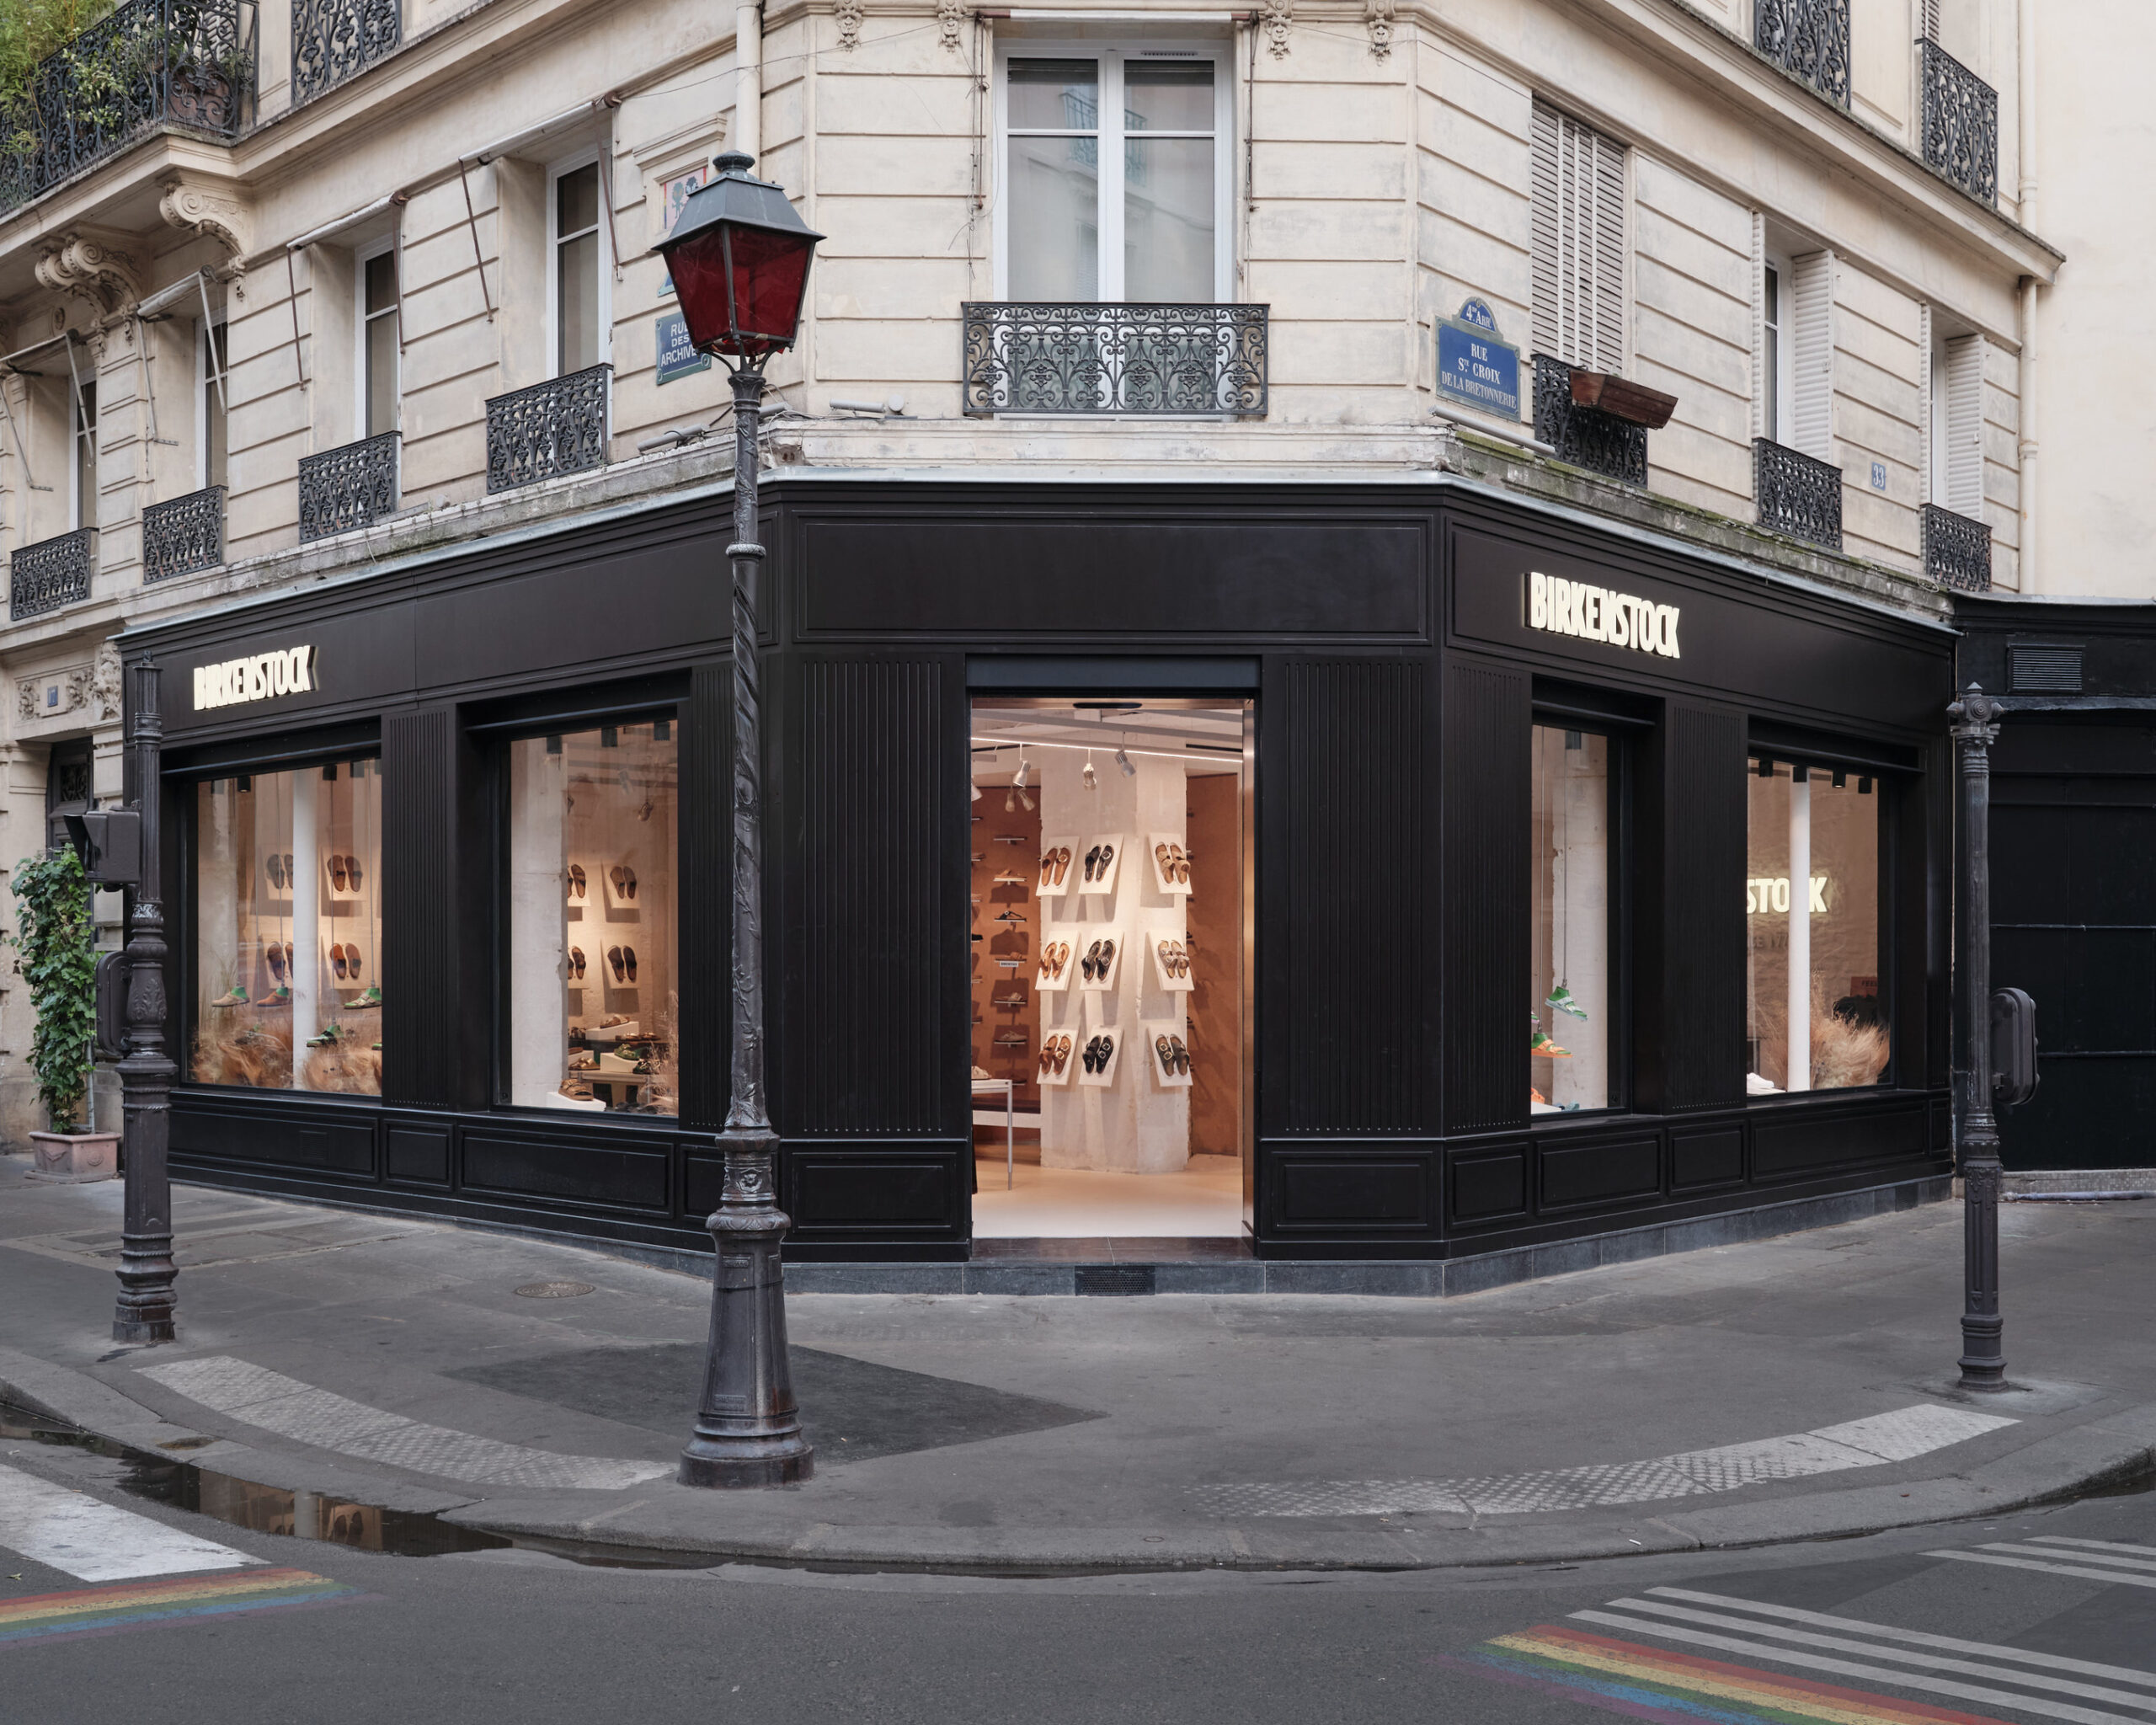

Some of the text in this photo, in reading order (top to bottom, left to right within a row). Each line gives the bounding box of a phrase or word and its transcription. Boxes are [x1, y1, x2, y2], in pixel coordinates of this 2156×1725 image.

[671, 334, 690, 348] DES
[1470, 343, 1487, 361] RUE
[660, 344, 697, 367] ARCHIVE
[1473, 364, 1501, 385] CROIX
[1442, 371, 1517, 409] DE LA BRETONNERIE
[1873, 465, 1884, 487] 33
[1530, 571, 1681, 659] BIRKENSTOCK
[194, 645, 311, 711] BIRKENSTOCK
[1747, 877, 1828, 914] STOK
